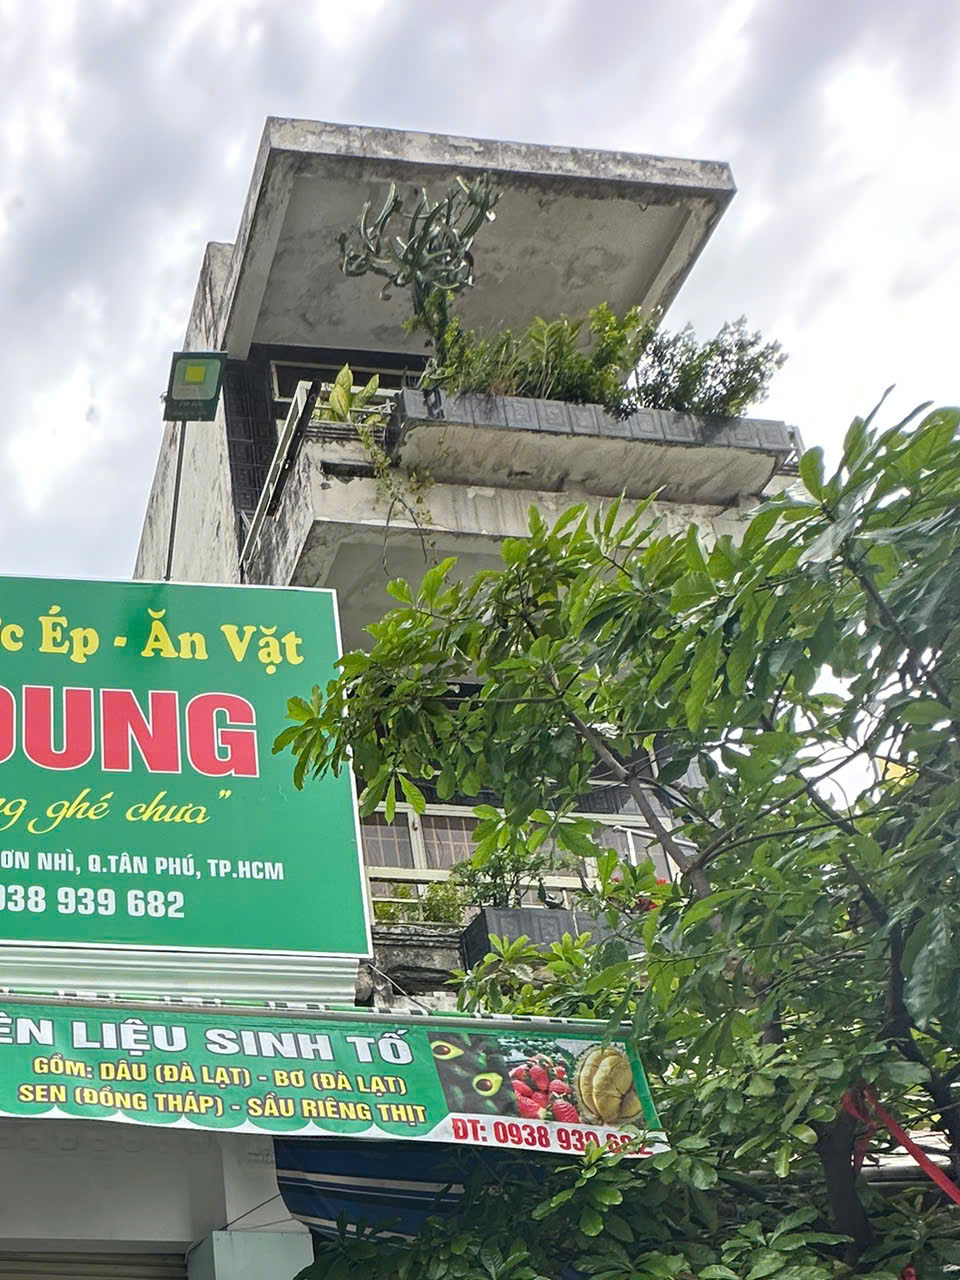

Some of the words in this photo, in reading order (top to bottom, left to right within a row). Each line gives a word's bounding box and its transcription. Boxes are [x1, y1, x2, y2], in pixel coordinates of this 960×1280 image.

[38, 605, 100, 664] Ép
[141, 608, 208, 660] Ăn
[220, 624, 304, 675] Vặt
[27, 788, 114, 835] ghé
[37, 849, 81, 876] NHÌ,
[88, 852, 148, 875] Q.TÂN
[155, 854, 201, 879] PHÚ,
[207, 858, 284, 881] TP.HCM
[57, 886, 116, 916] 939
[127, 889, 185, 918] 682
[71, 1017, 188, 1056] LIỆU
[204, 1028, 334, 1061] SINH
[345, 1029, 414, 1065] TỐ
[33, 1053, 93, 1079] GỒM:
[99, 1060, 148, 1081] DÂU
[155, 1061, 197, 1084] (ĐÀ
[202, 1066, 251, 1088] LẠT)
[273, 1069, 306, 1088] BƠ
[312, 1071, 353, 1092] (ĐÀ
[356, 1075, 408, 1097] LẠT)
[18, 1084, 67, 1103] SEN
[154, 1091, 224, 1117] THÁP)
[247, 1091, 295, 1118] SẦU
[301, 1097, 373, 1121] RIÊNG
[376, 1103, 427, 1127] THỊT
[451, 1117, 487, 1142] ĐT:
[493, 1121, 551, 1149] 0938
